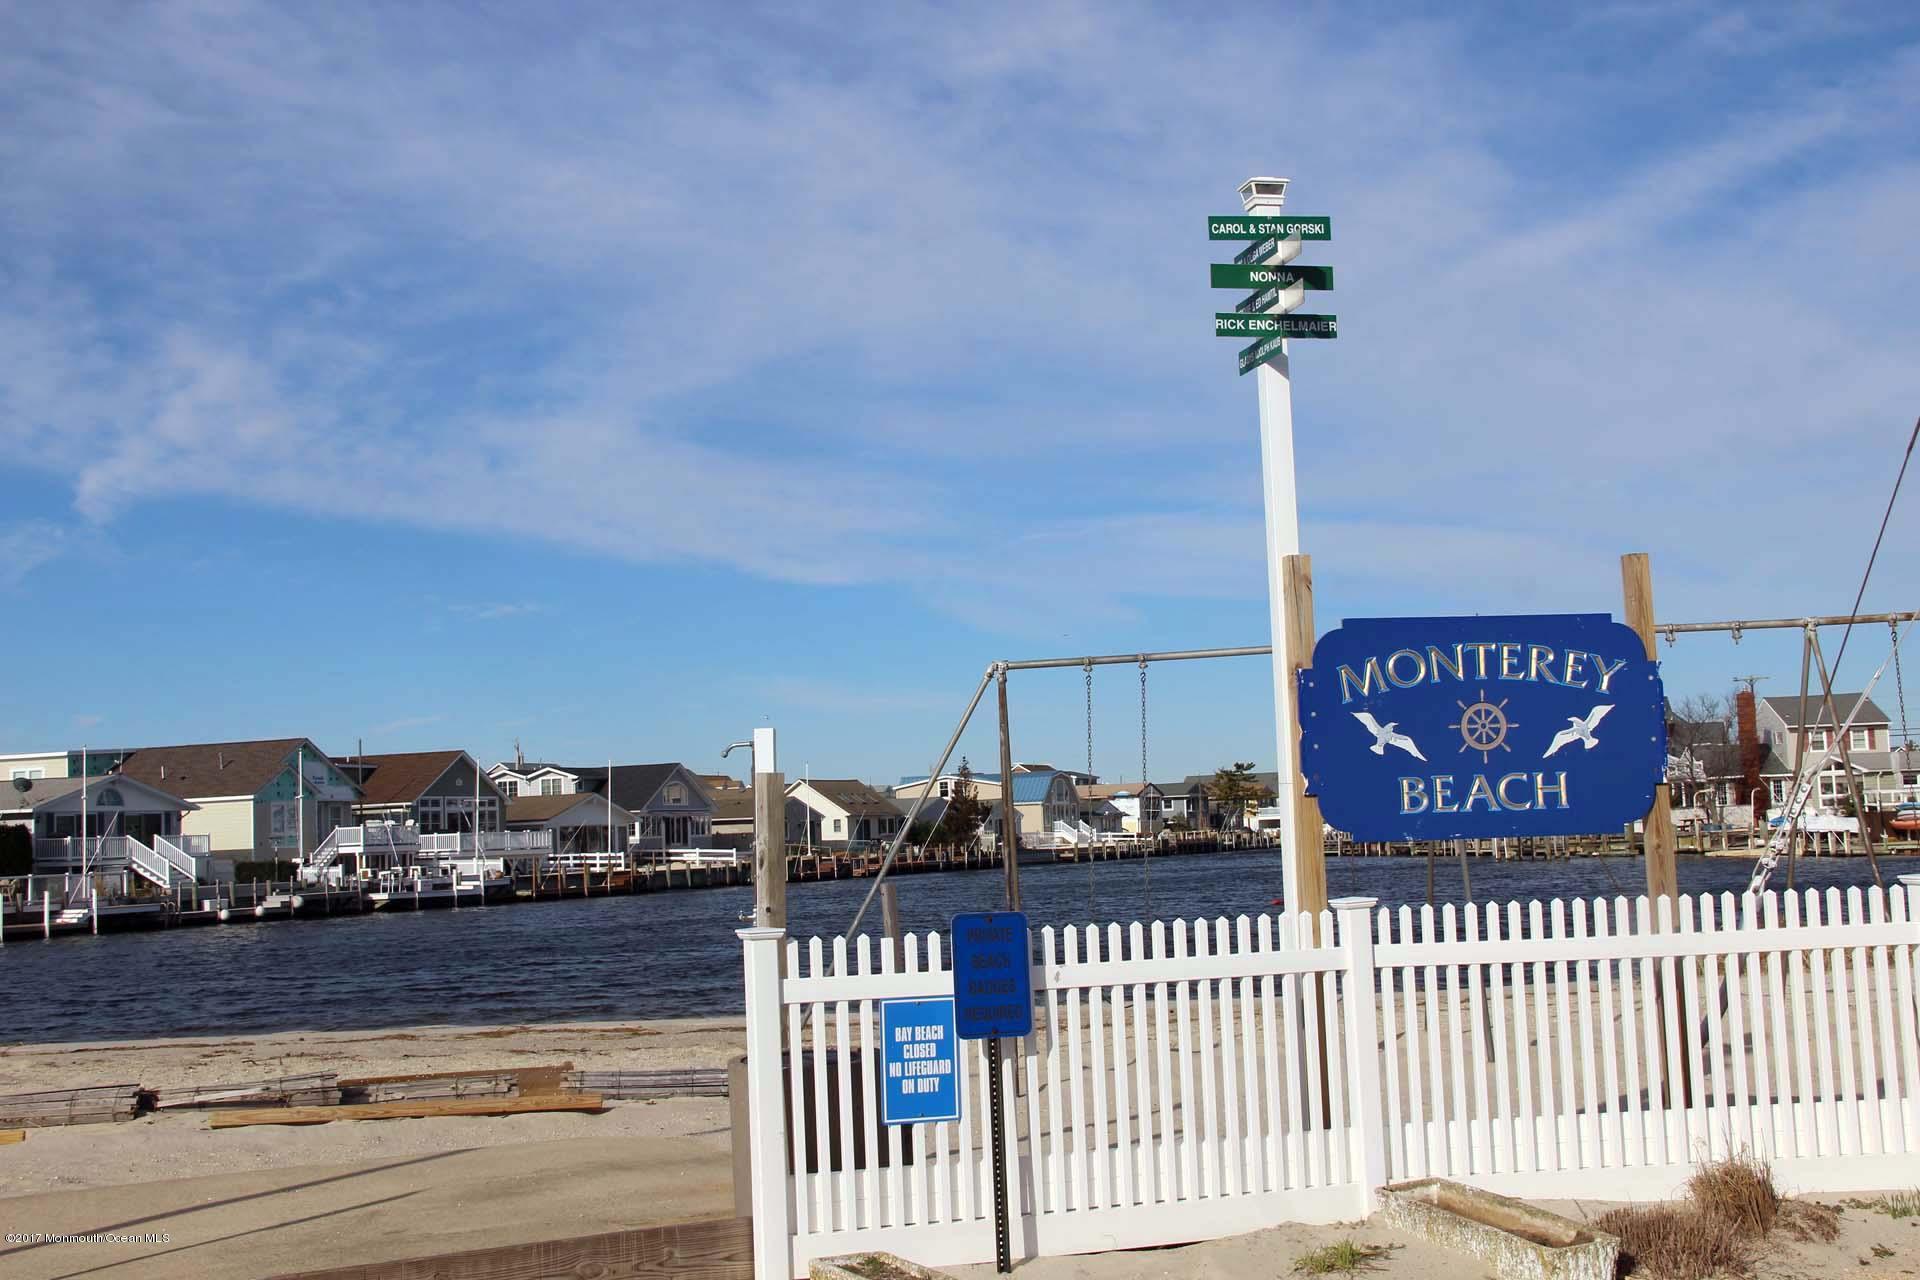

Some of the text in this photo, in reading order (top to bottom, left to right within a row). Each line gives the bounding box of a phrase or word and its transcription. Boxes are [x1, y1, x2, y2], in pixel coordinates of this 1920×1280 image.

[1212, 223, 1325, 234] CAROL & STAN GORSKI
[1250, 271, 1295, 283] NONNA
[1216, 319, 1337, 332] RICK ENCHELMAIER
[1336, 642, 1628, 704] MONTEREY
[1398, 771, 1570, 815] BEACH
[967, 928, 1013, 943] PRIVATE
[972, 953, 1010, 968] BEACH
[895, 1025, 944, 1042] BAY BEACH
[903, 1043, 936, 1059] CLOSED
[889, 1059, 952, 1078] NO LIFEGUARD
[902, 1077, 940, 1094] ON DUTY
